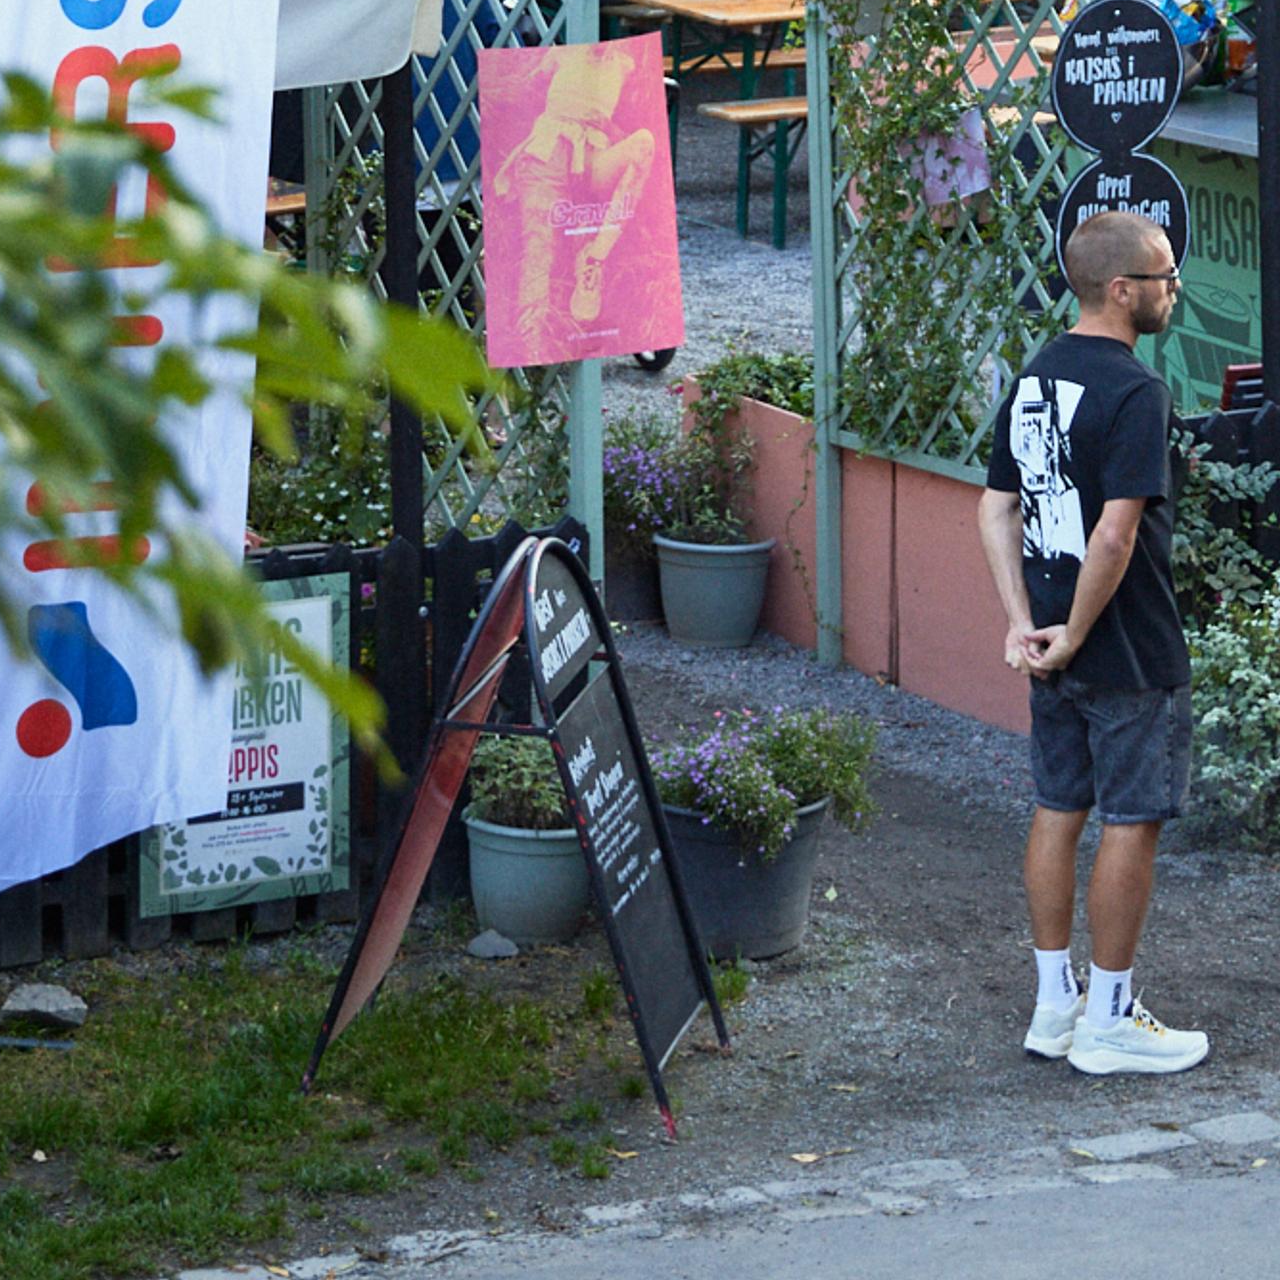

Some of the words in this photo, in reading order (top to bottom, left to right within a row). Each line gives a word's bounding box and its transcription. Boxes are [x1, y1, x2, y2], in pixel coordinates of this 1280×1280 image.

[1065, 55, 1122, 85] KAJSAS
[1094, 77, 1165, 105] PARKEN
[1187, 184, 1258, 271] KAJSA
[228, 744, 279, 785] PPIS
